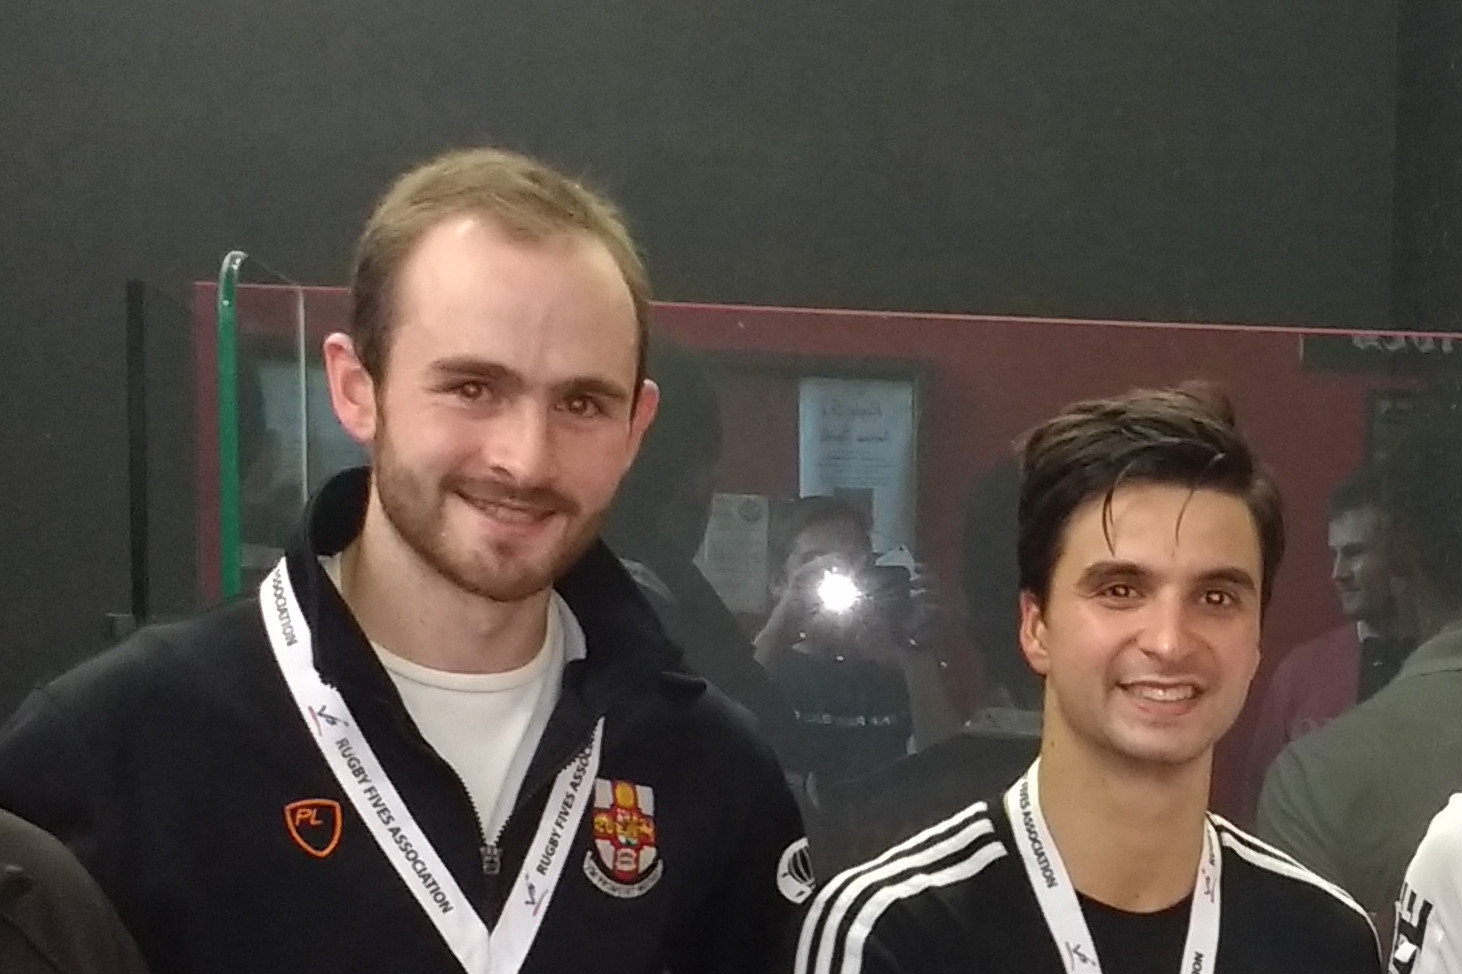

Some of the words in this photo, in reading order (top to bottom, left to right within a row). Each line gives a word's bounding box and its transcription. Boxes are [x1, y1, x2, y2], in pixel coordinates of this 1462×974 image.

[295, 808, 323, 827] PL
[335, 737, 372, 785] RUGBY
[364, 786, 395, 826] FIVES
[389, 827, 453, 914] ASSOCIATION
[537, 827, 562, 876] RUGBY
[555, 791, 576, 830] FIVES
[1022, 811, 1058, 889] ASSOCIATION
